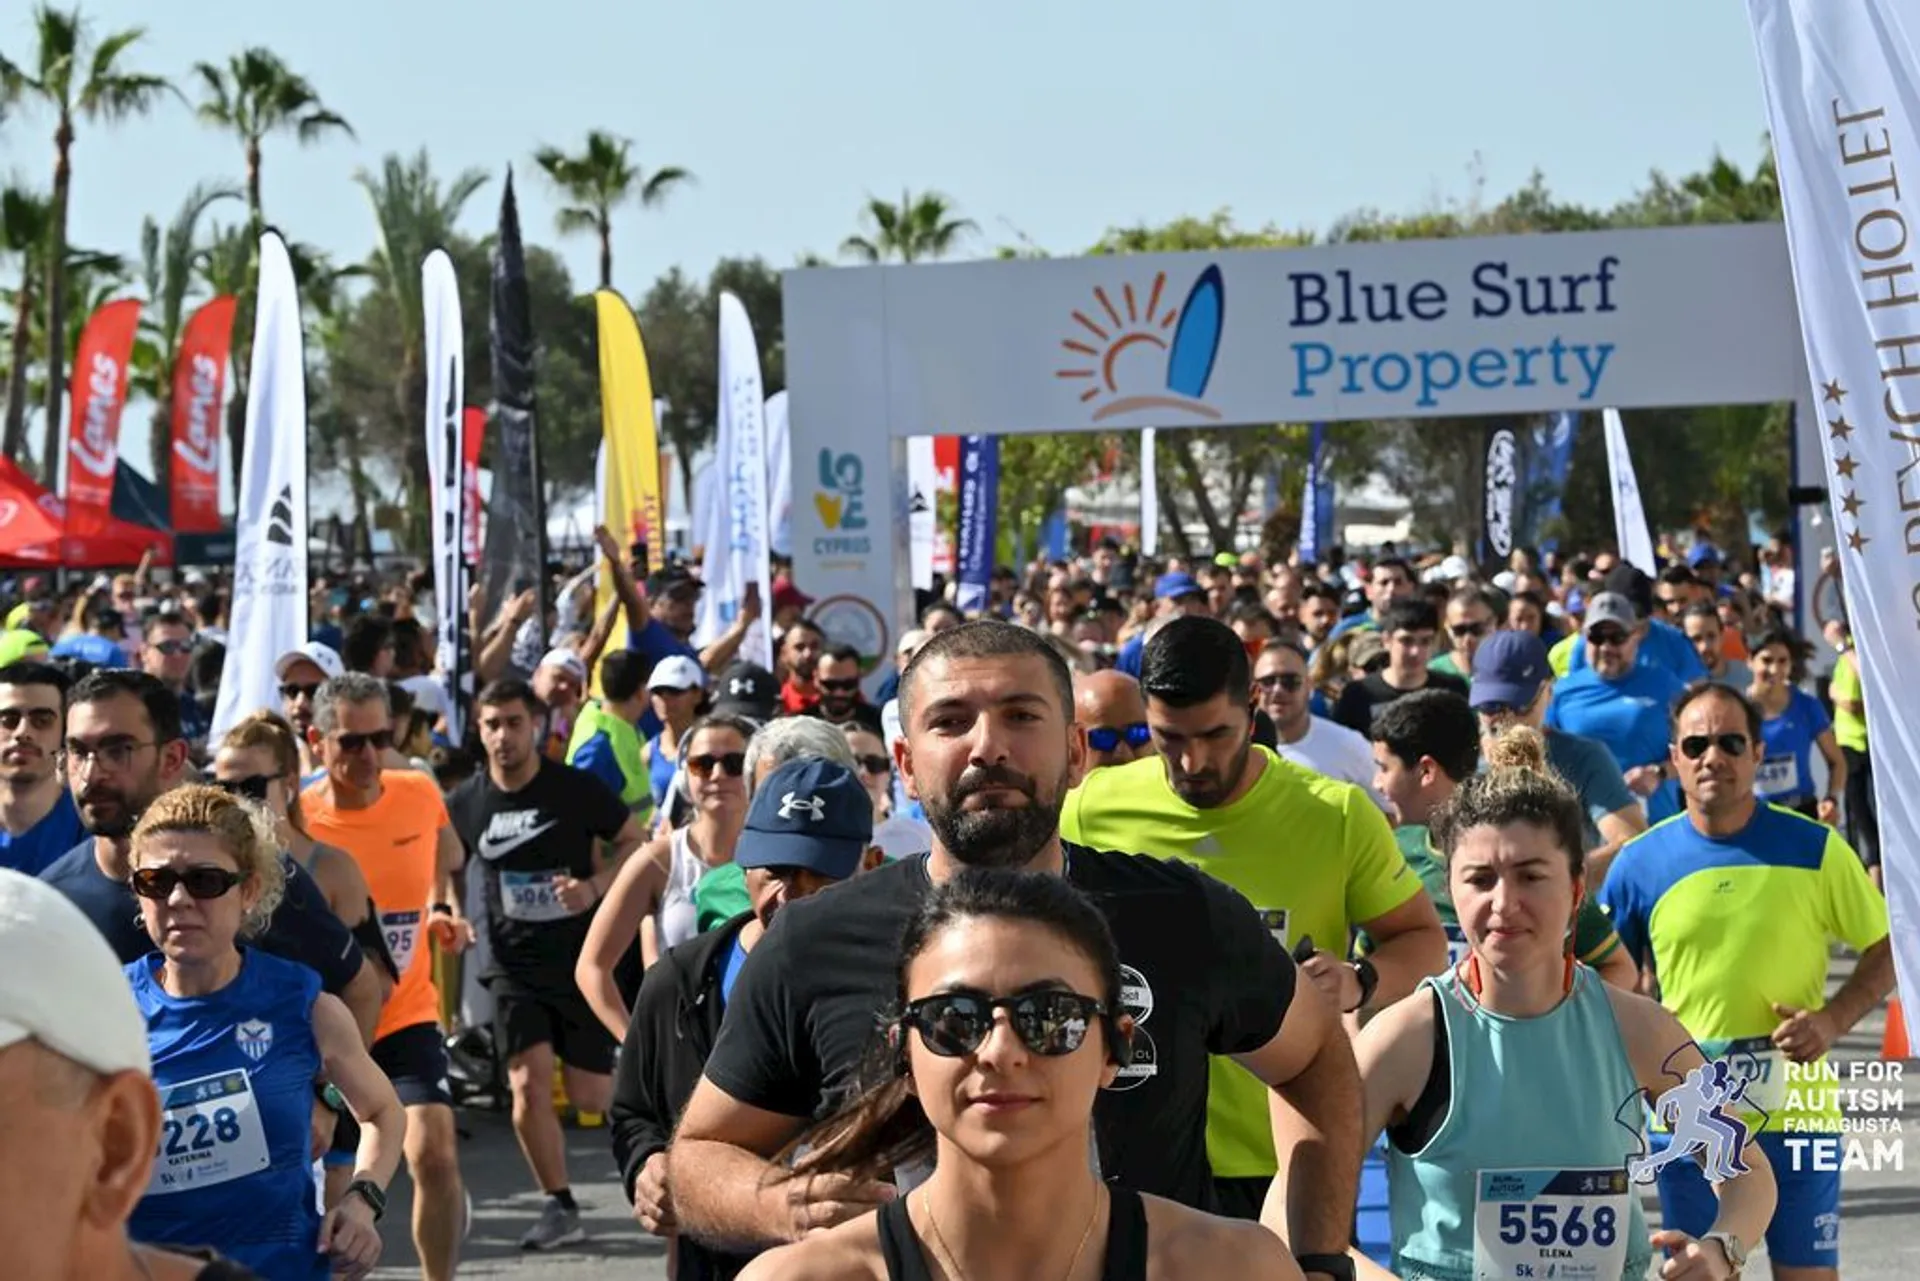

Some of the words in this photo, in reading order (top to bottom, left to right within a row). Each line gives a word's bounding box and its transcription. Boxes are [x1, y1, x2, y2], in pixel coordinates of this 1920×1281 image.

[1288, 270, 1447, 327] Blue
[1473, 257, 1619, 318] Surf
[1290, 336, 1615, 406] Property
[487, 809, 540, 840] NIKE
[156, 1106, 241, 1157] 228
[168, 1150, 212, 1165] KATERINA
[1499, 1204, 1616, 1247] 5568
[1516, 1263, 1534, 1277] 5k
[1539, 1248, 1573, 1258] ELENA
